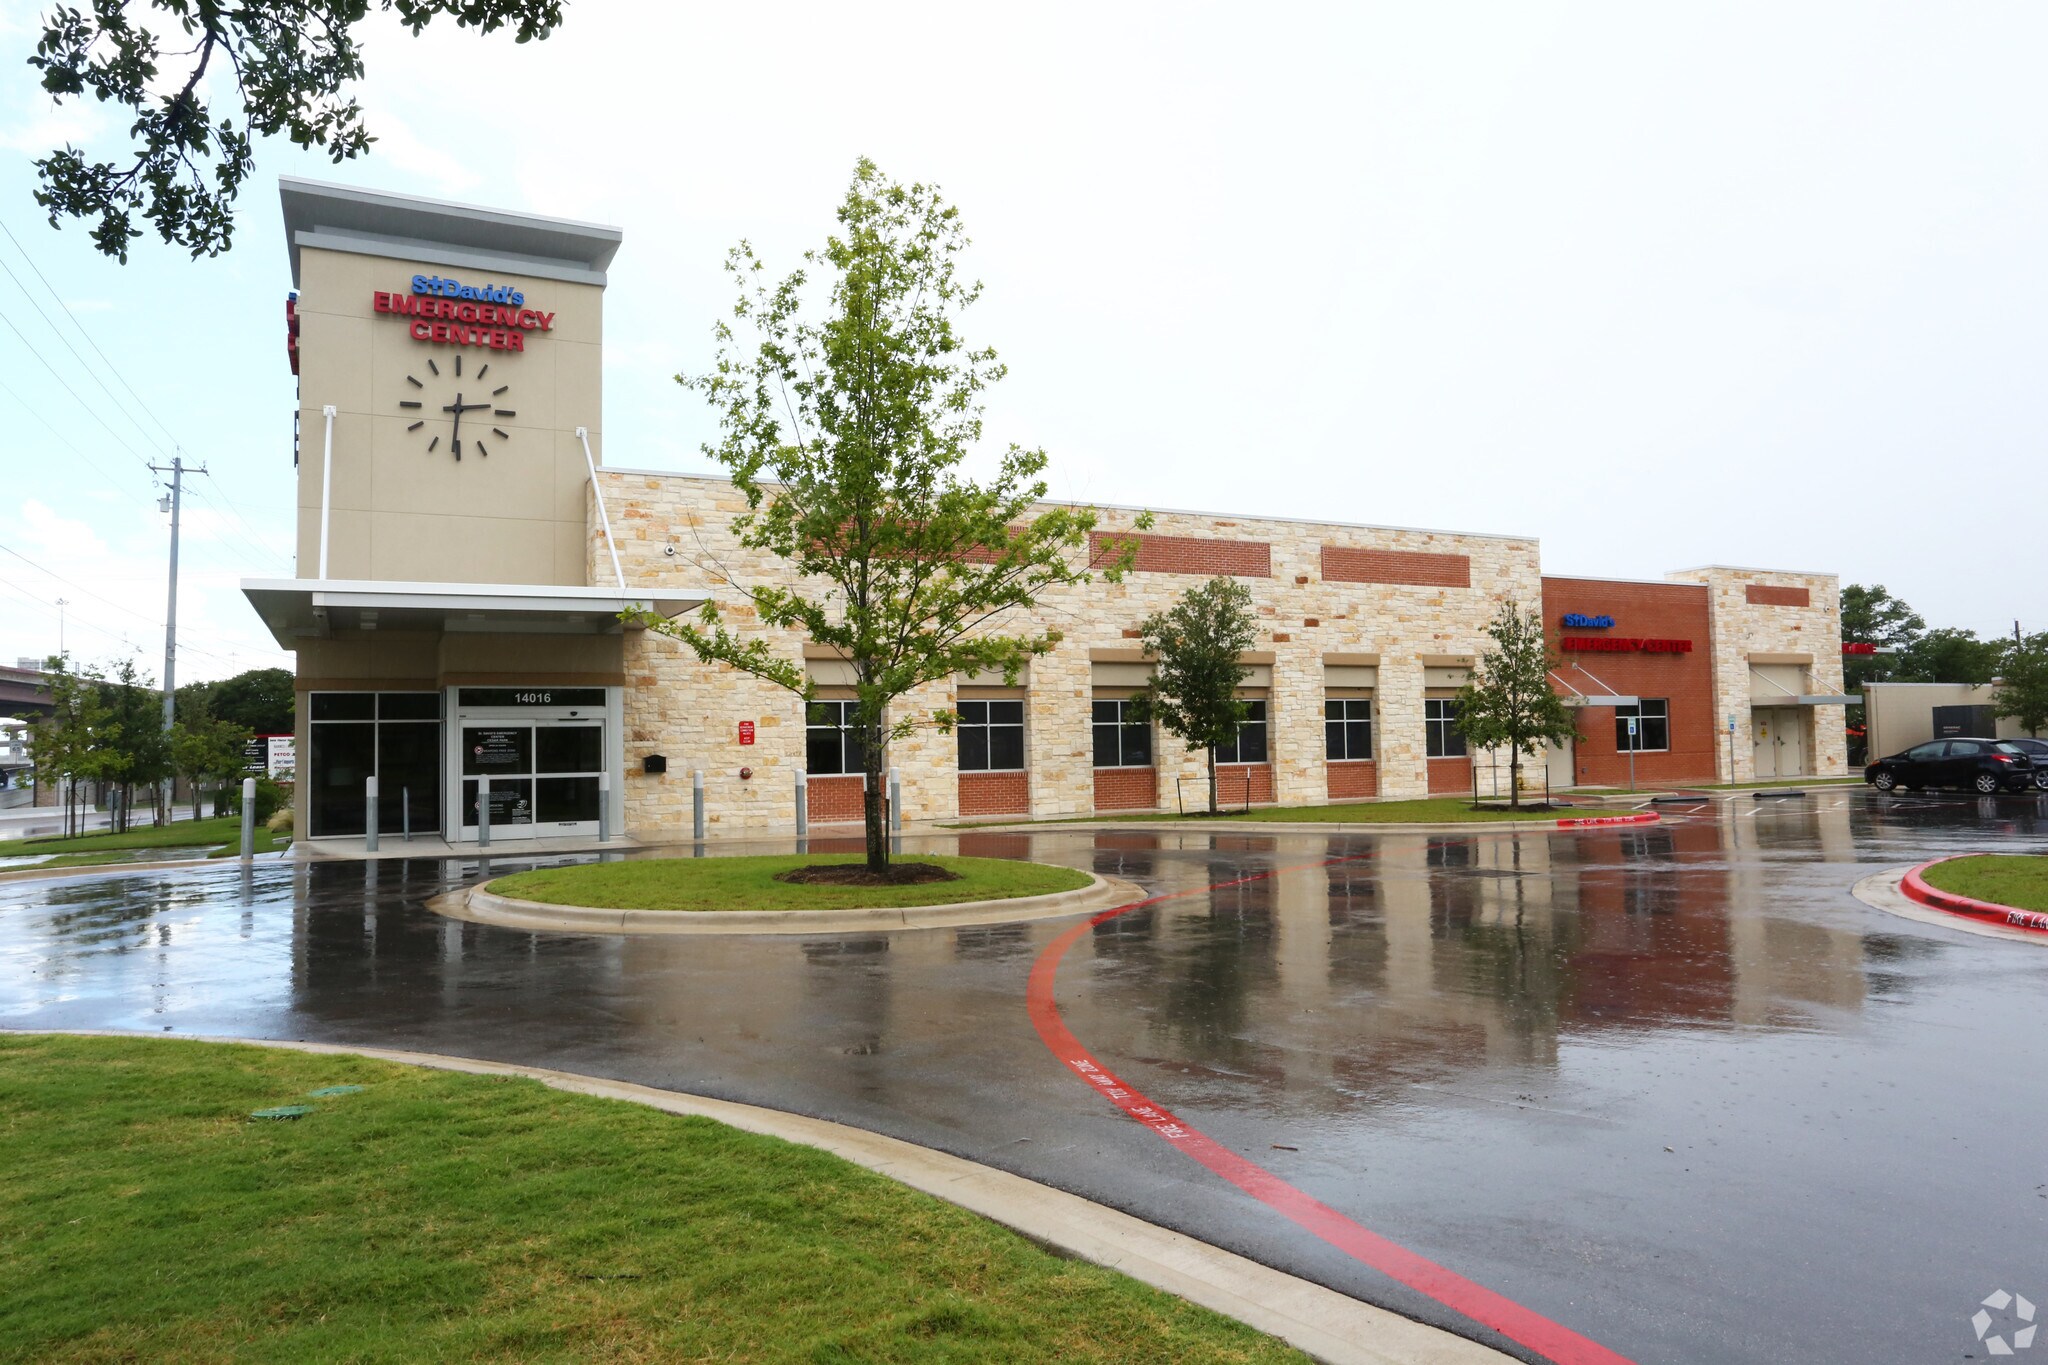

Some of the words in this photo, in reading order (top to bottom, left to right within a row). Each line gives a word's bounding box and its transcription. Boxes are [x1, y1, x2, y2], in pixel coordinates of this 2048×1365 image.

[373, 290, 556, 332] EMERGENCY
[409, 319, 525, 352] CENTER
[1563, 637, 1644, 652] EMERGENCY
[1643, 639, 1692, 653] CENTER
[514, 693, 551, 703] 14016
[2006, 911, 2030, 926] FIRE
[1069, 1059, 1100, 1073] ZONE
[1130, 1106, 1167, 1122] LANE
[1155, 1122, 1190, 1139] FIRE
